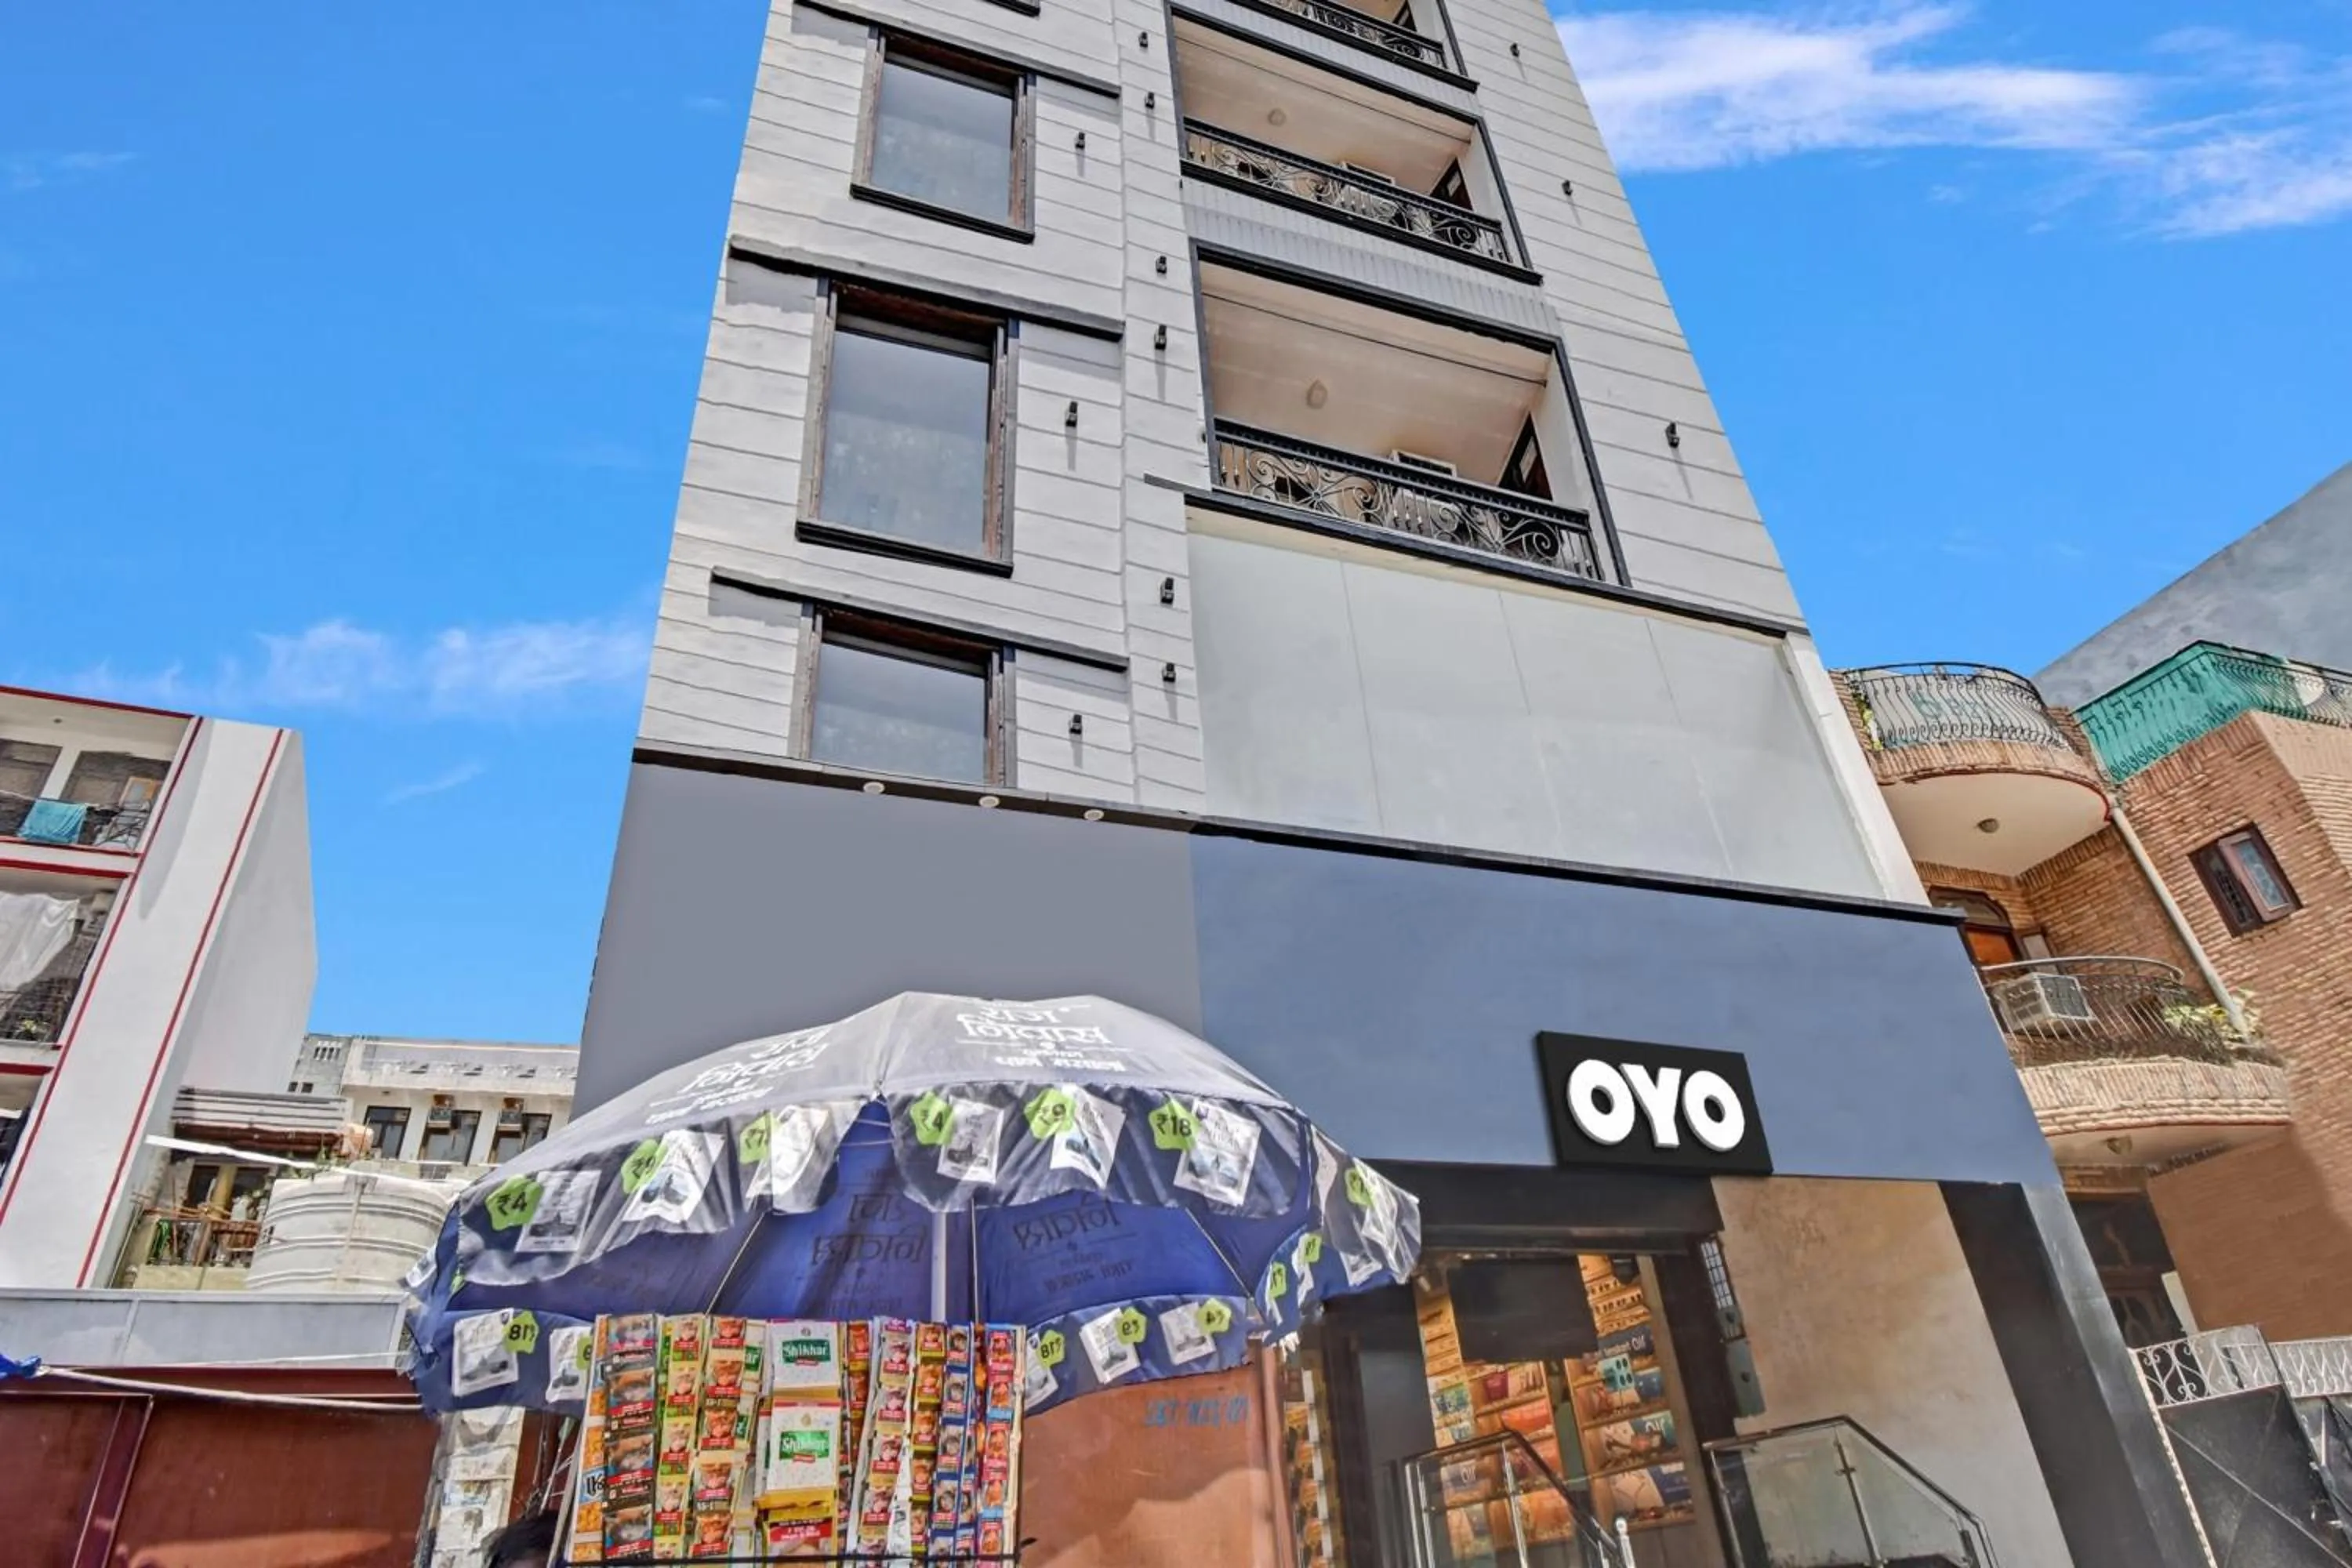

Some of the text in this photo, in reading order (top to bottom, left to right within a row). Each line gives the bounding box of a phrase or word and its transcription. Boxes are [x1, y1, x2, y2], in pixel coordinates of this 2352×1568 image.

[1567, 1058, 1745, 1152] OYO
[1156, 1113, 1192, 1137] ₹18
[497, 1191, 528, 1216] ₹4
[782, 1341, 829, 1357] Shikhar
